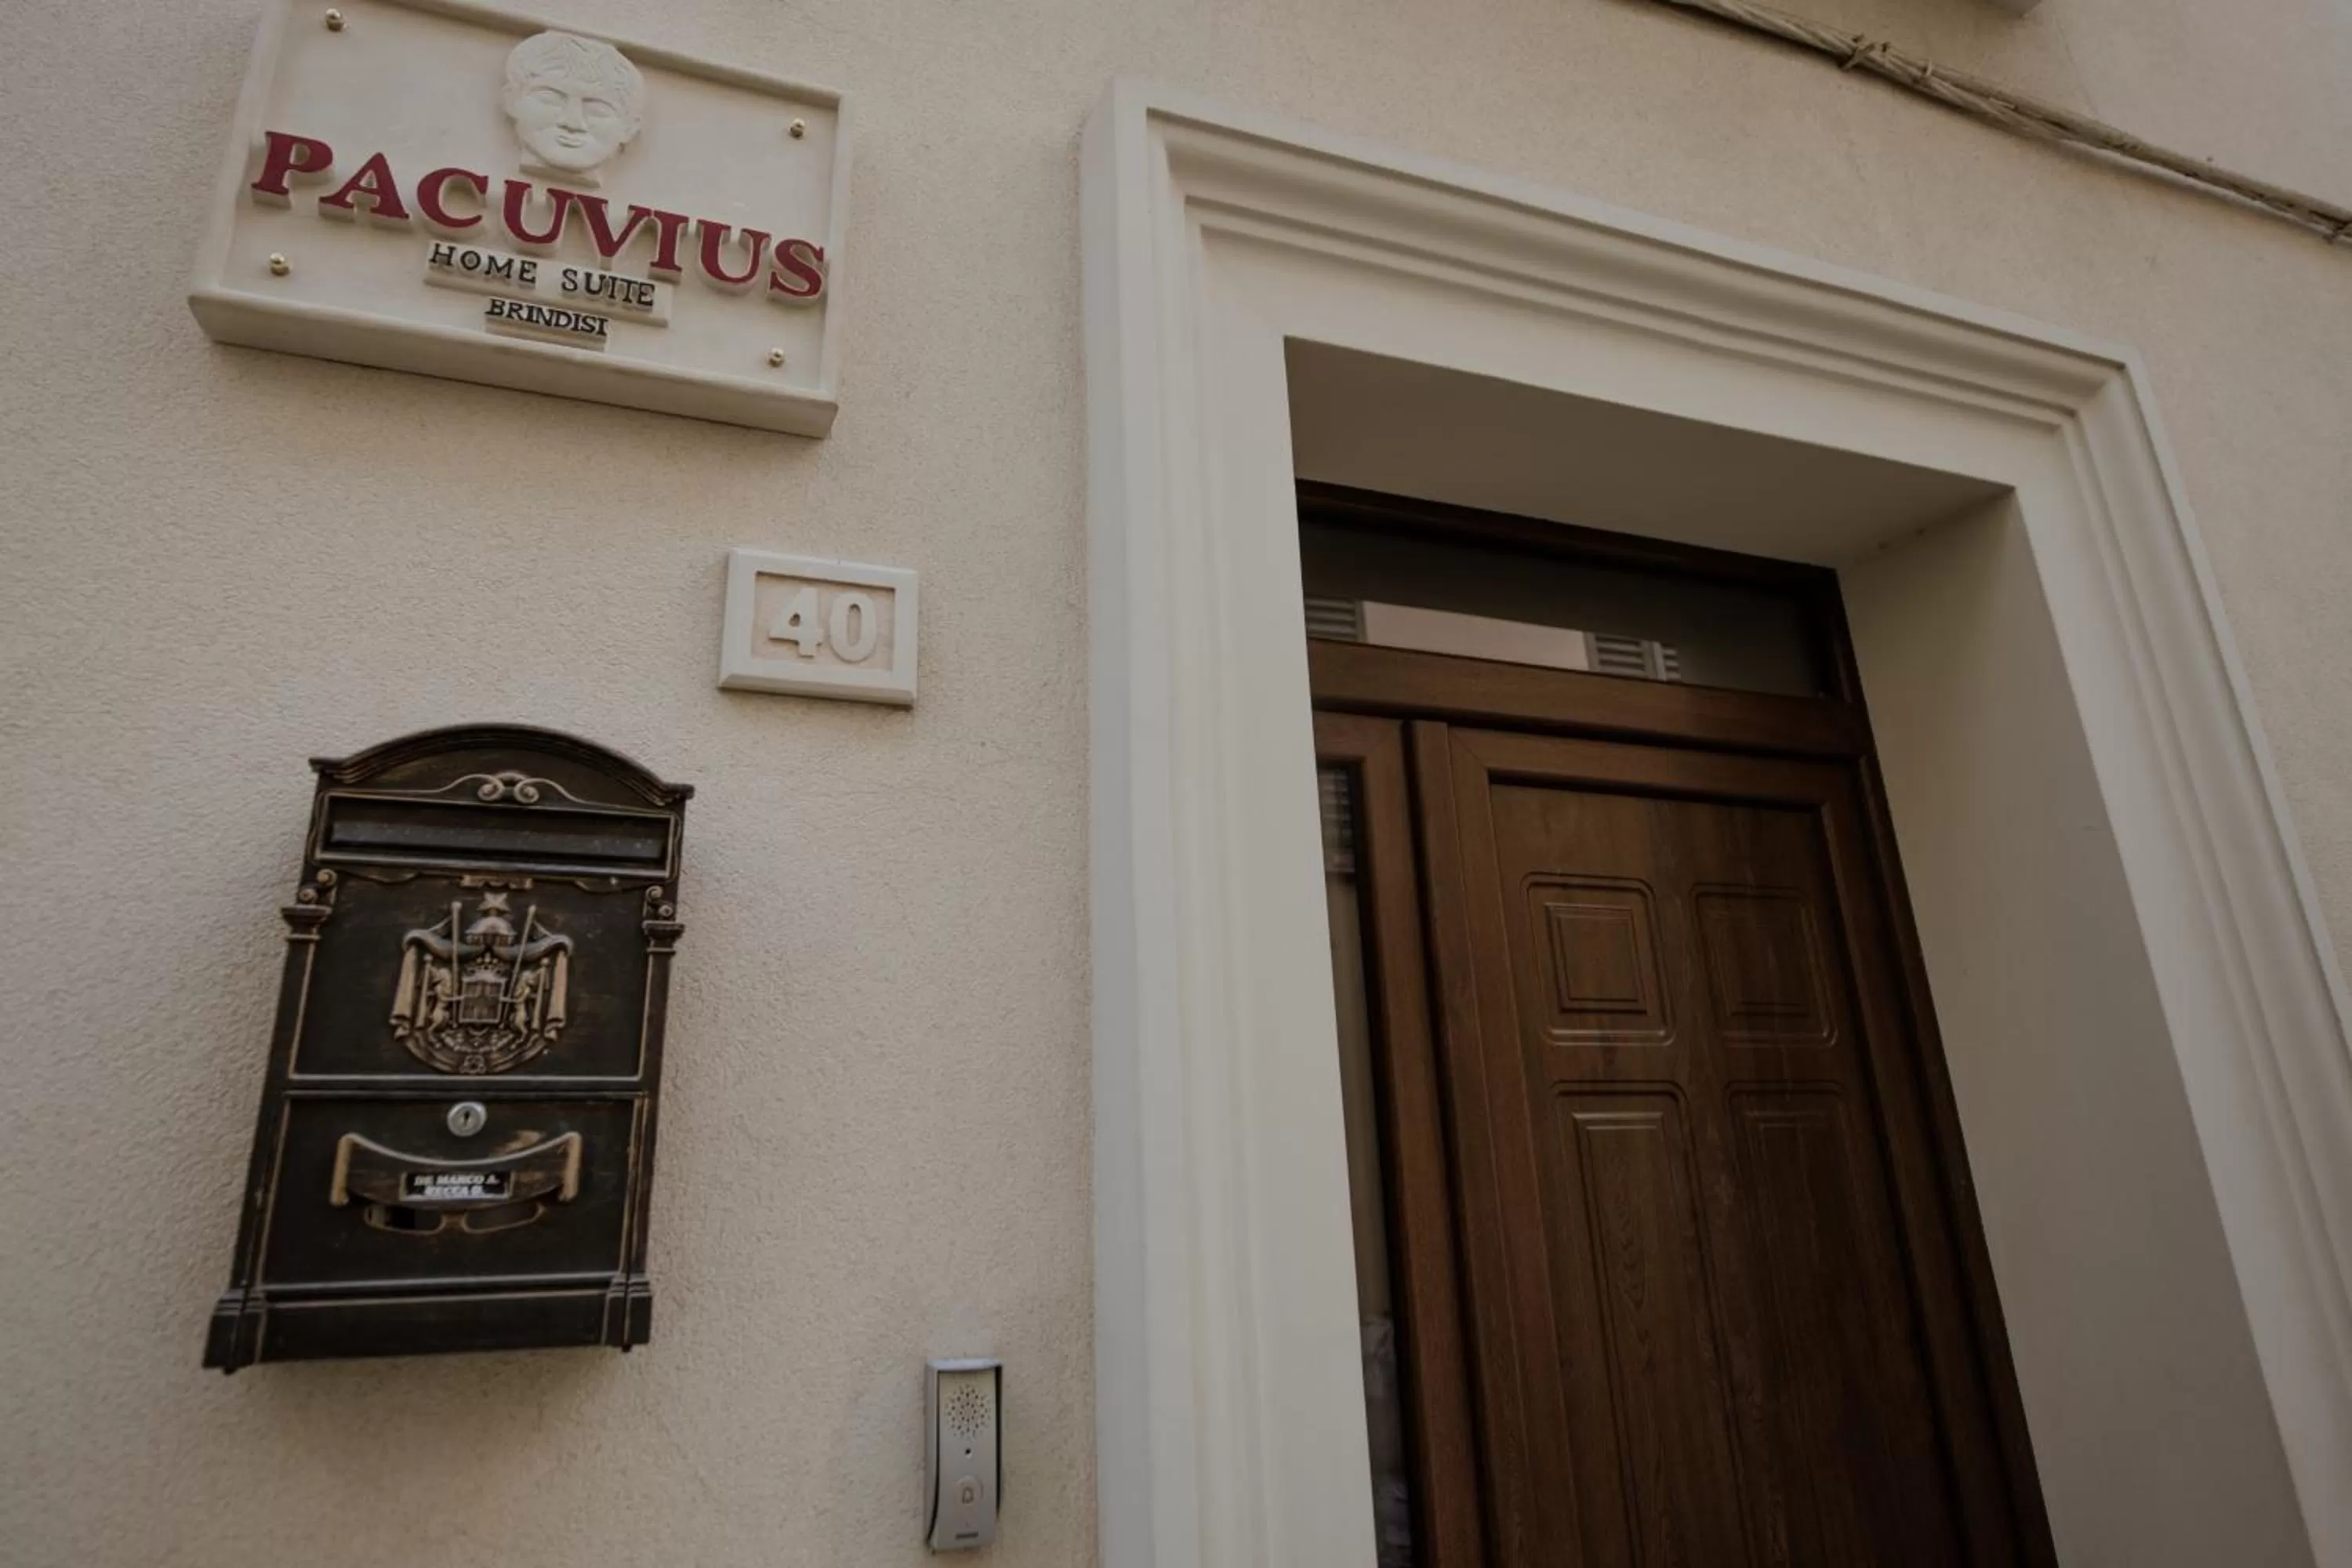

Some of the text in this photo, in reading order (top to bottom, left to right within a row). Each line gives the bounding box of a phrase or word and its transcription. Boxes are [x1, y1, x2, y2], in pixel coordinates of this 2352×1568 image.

[251, 131, 826, 298] PACUVIUS
[430, 243, 655, 307] HOME SUITE
[485, 299, 608, 336] BRINDISI
[768, 587, 877, 663] 40
